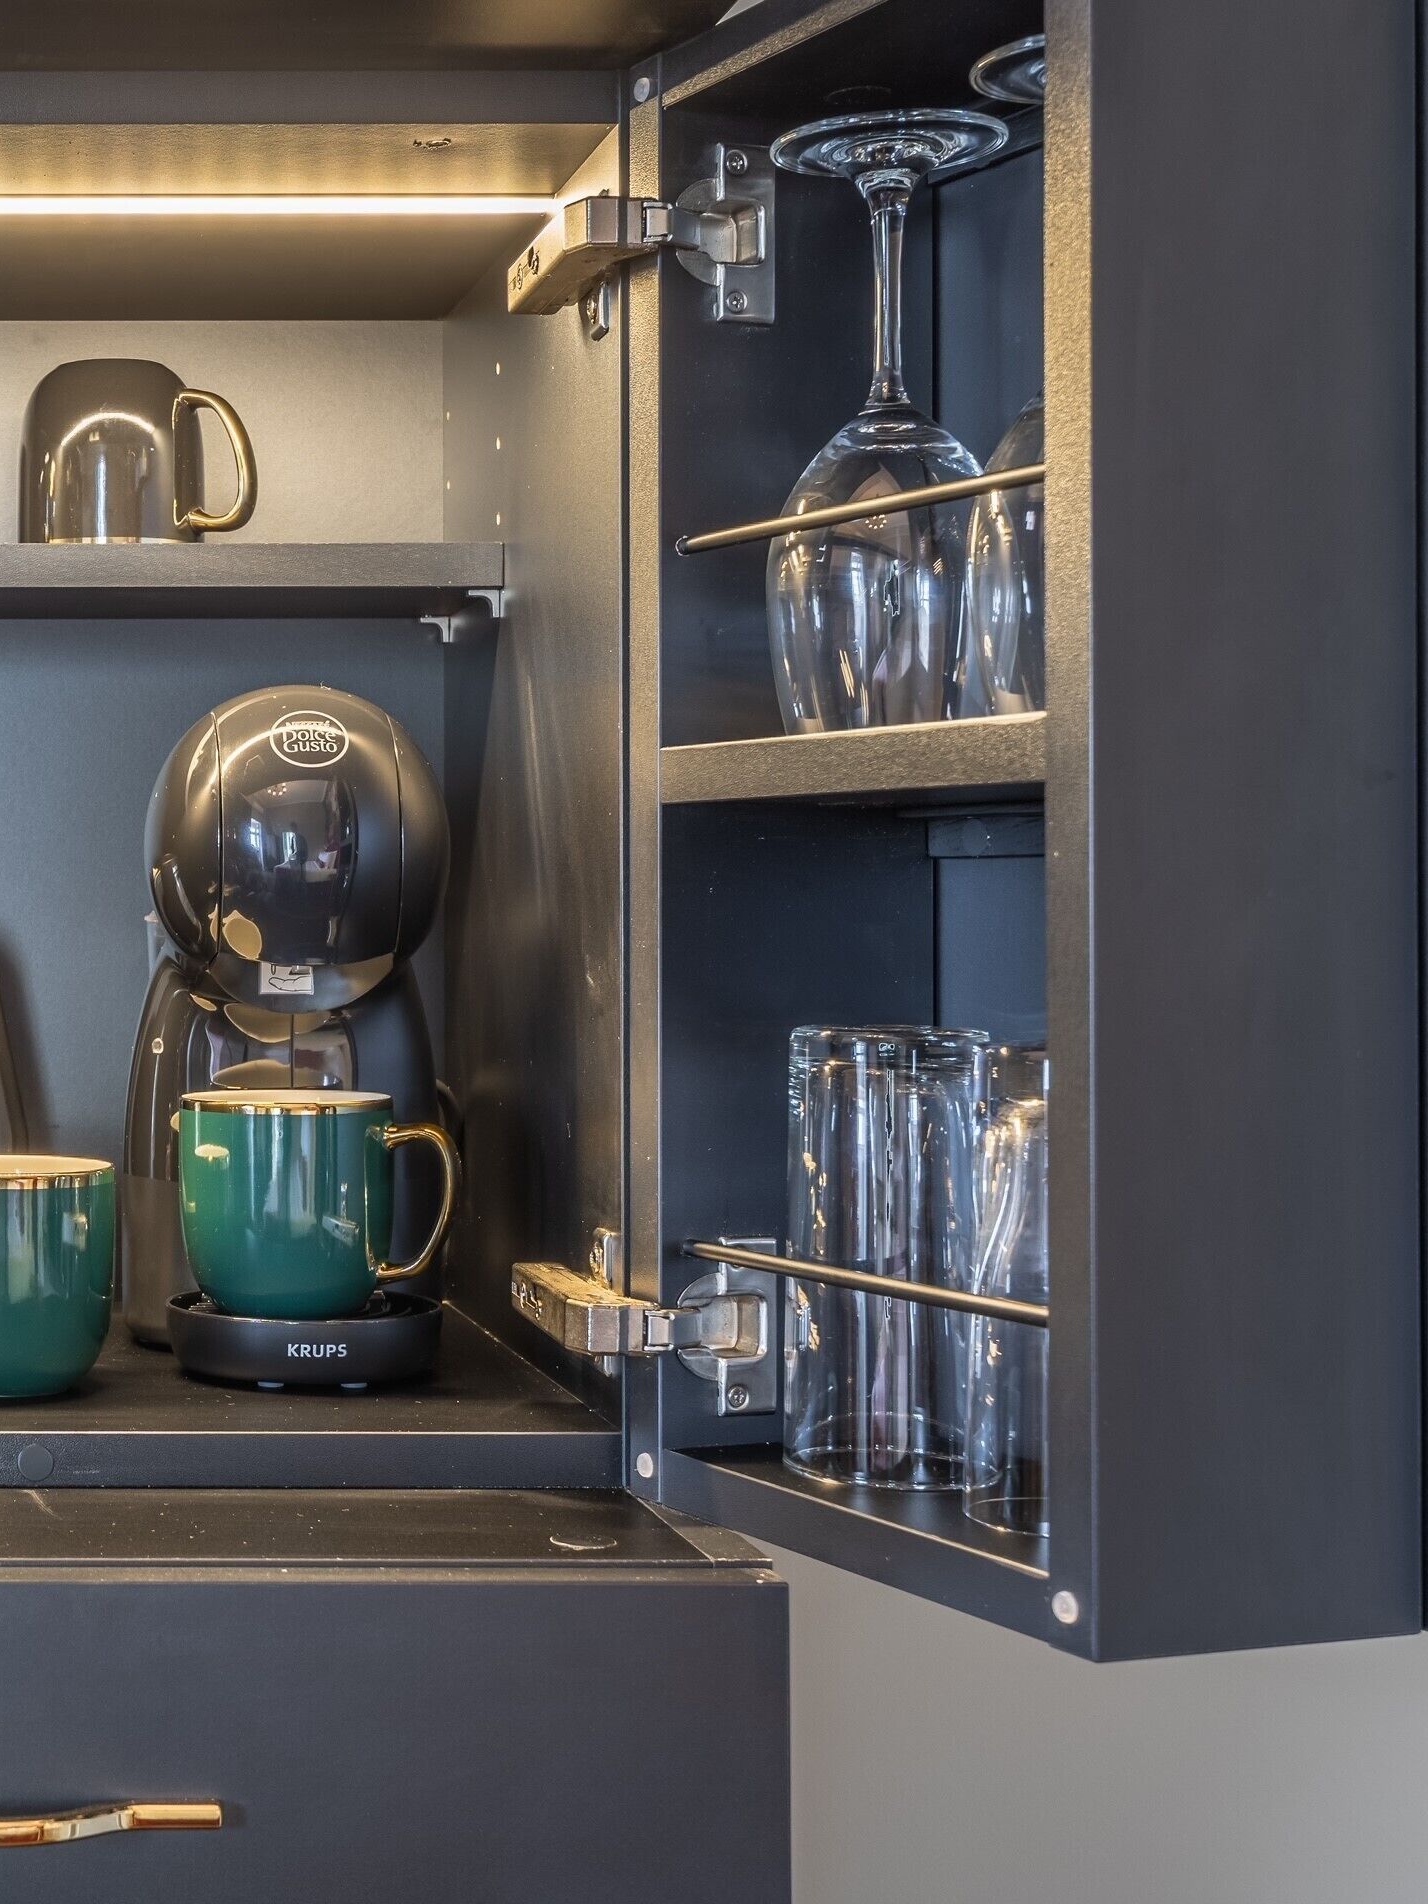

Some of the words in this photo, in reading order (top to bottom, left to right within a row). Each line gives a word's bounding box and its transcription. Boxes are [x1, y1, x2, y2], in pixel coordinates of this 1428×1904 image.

[283, 729, 336, 743] Dolce
[283, 739, 338, 753] Gusto
[287, 1343, 348, 1358] KRUPS
